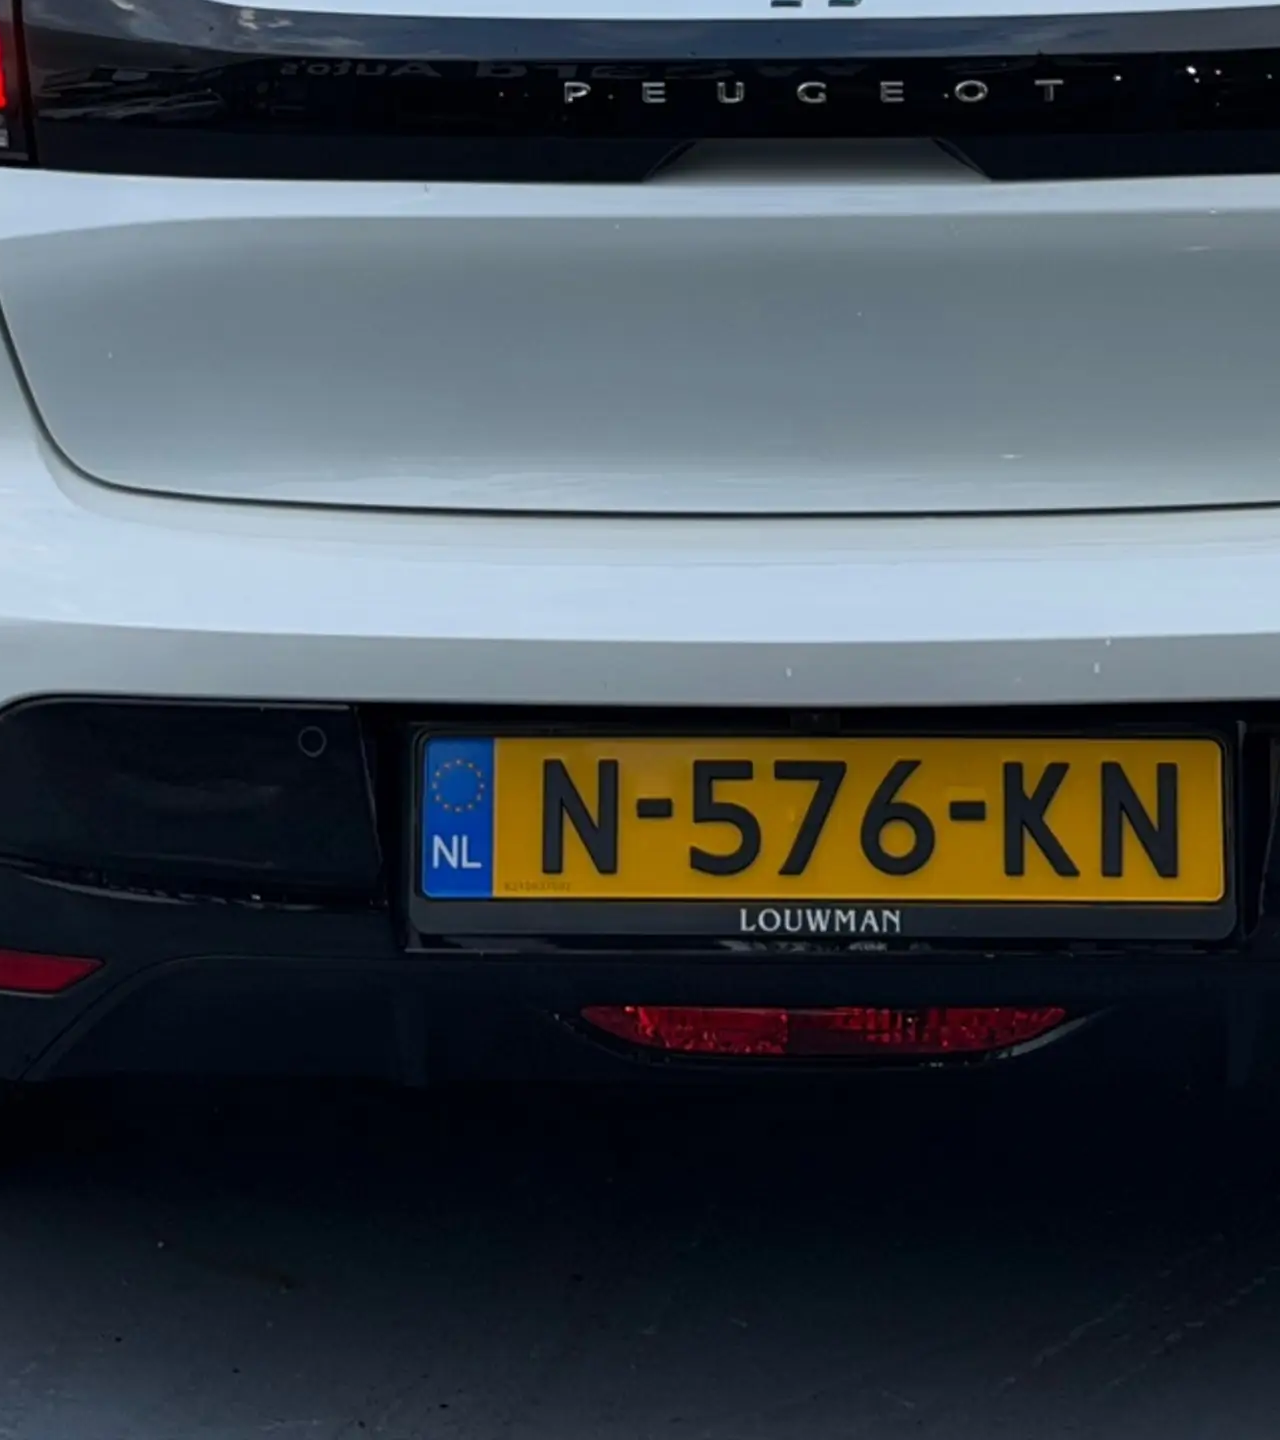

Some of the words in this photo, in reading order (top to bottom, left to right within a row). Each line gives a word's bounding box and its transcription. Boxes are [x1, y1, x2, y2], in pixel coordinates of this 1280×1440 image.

[563, 79, 1064, 104] PEUGEOT
[541, 758, 1179, 879] N-576-KN
[432, 834, 483, 870] NL
[739, 907, 902, 934] LOUWMAN
